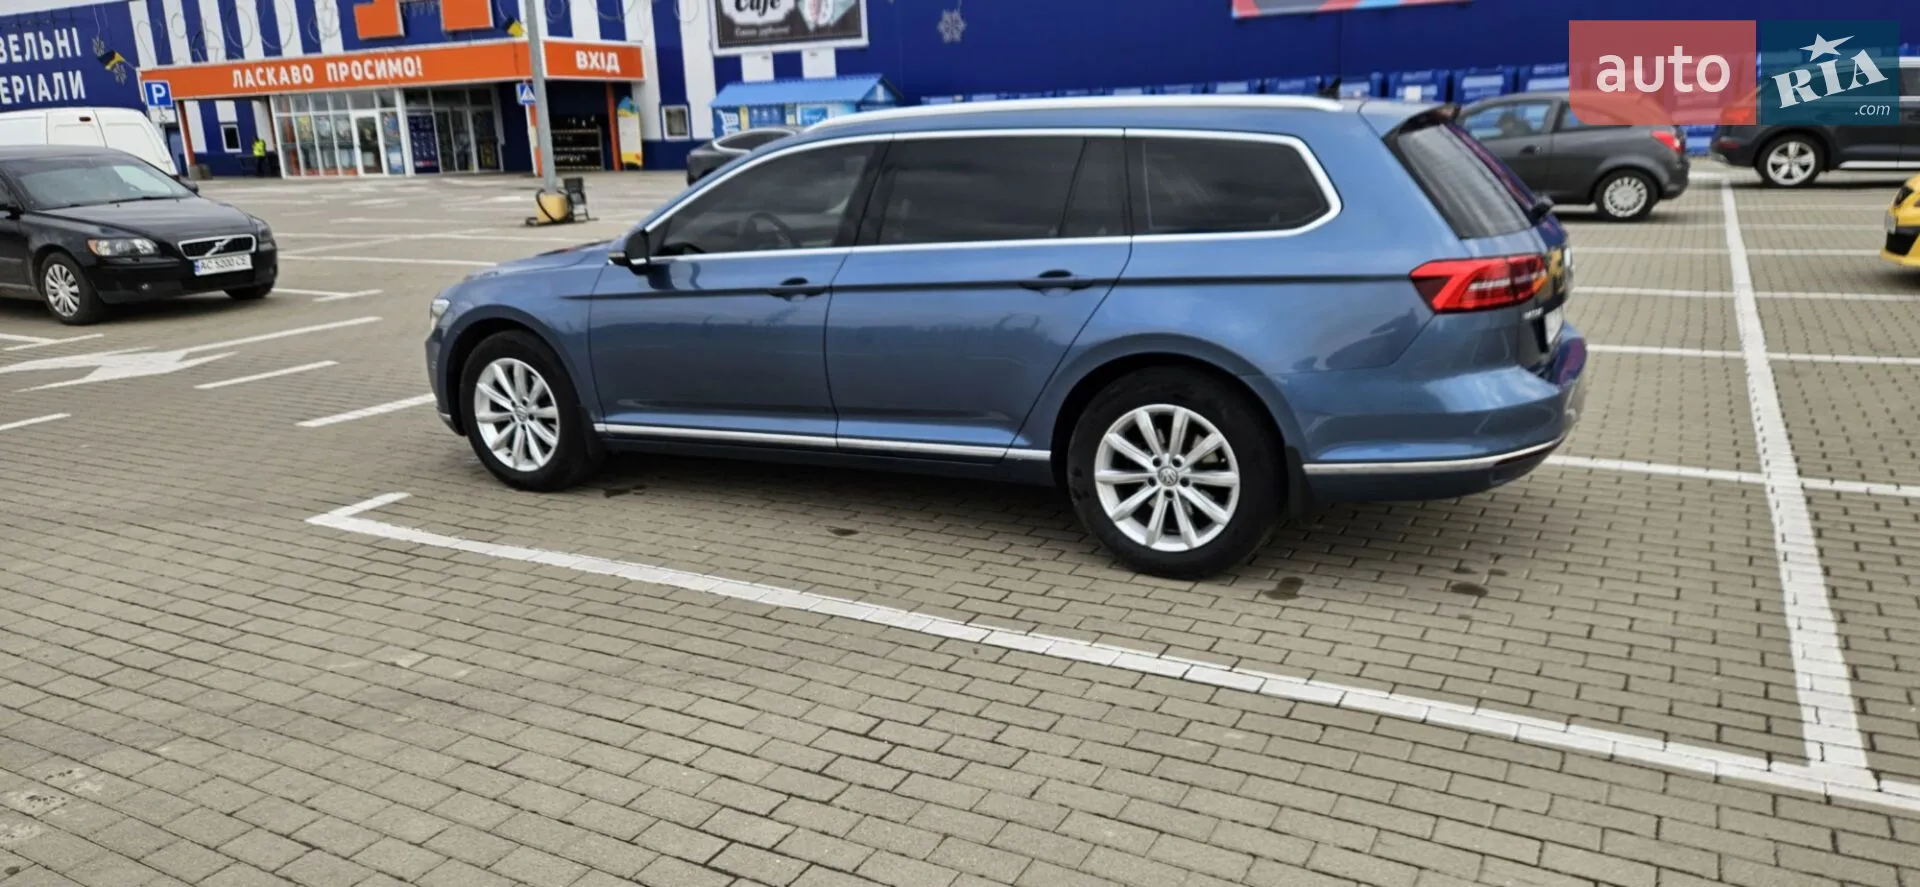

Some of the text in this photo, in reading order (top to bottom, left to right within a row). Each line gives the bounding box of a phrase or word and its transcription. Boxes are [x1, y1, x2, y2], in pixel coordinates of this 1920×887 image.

[232, 55, 424, 89] ЛАСКАВО ПРОСИМО!
[575, 50, 621, 73] ВХІД
[0, 70, 87, 105] ЕРІАЛИ
[151, 83, 166, 104] P
